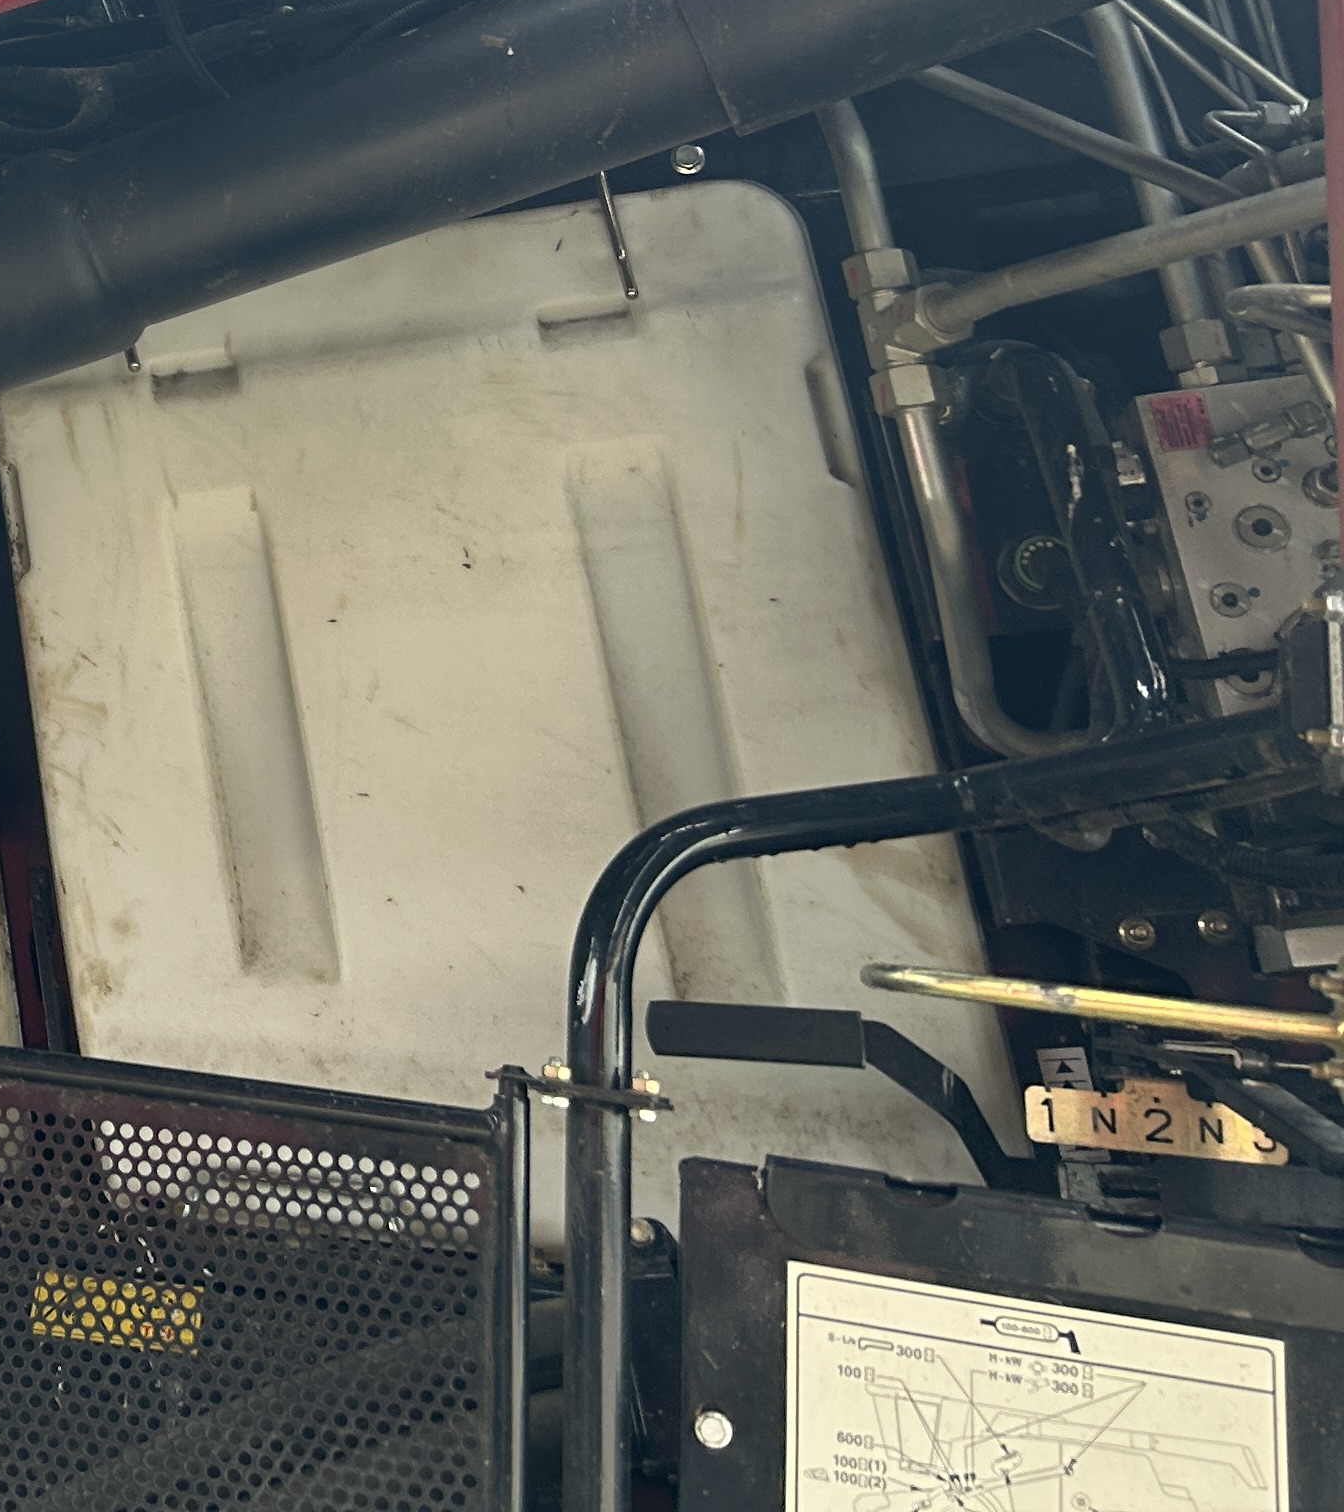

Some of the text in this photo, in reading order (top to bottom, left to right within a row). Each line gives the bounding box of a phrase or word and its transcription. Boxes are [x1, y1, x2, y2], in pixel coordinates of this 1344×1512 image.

[1041, 1098, 1224, 1144] 1 N 2 N
[896, 1344, 922, 1360] 300
[838, 1364, 862, 1379] 100
[1052, 1362, 1079, 1376] 300
[1052, 1380, 1079, 1396] 300
[833, 1453, 858, 1470] 100
[834, 1469, 858, 1485] 100
